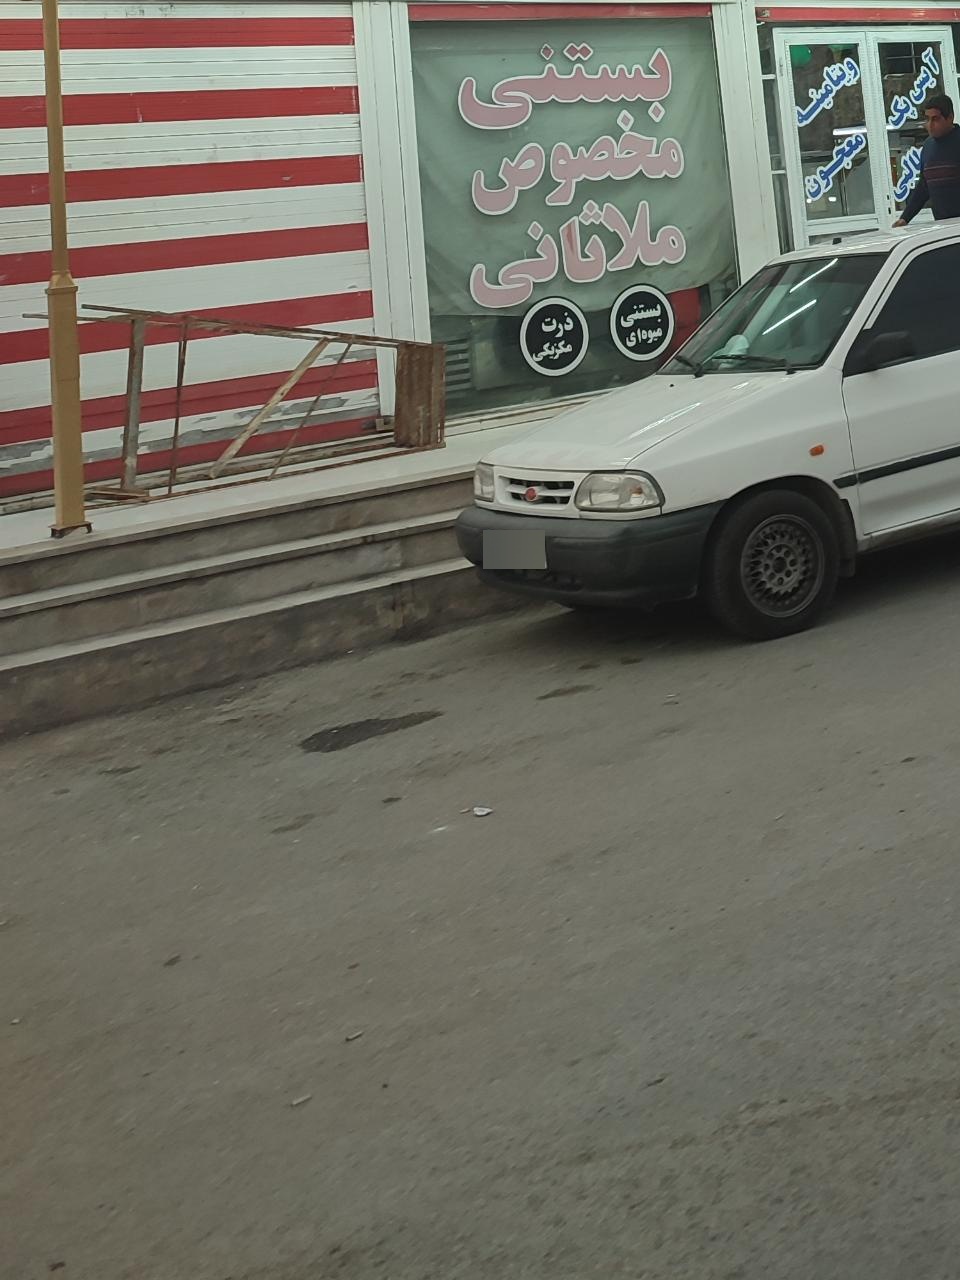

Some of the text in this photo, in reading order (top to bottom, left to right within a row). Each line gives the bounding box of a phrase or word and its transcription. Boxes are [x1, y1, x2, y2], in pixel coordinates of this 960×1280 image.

[457, 42, 674, 132] بستنی
[910, 47, 940, 105] آیس
[470, 109, 686, 216] مخصوص
[805, 134, 866, 201] معجون
[468, 200, 687, 309] ملاثانی
[541, 311, 574, 338] ذرت
[620, 303, 662, 328] بستنی
[532, 340, 573, 363] مکزیکی
